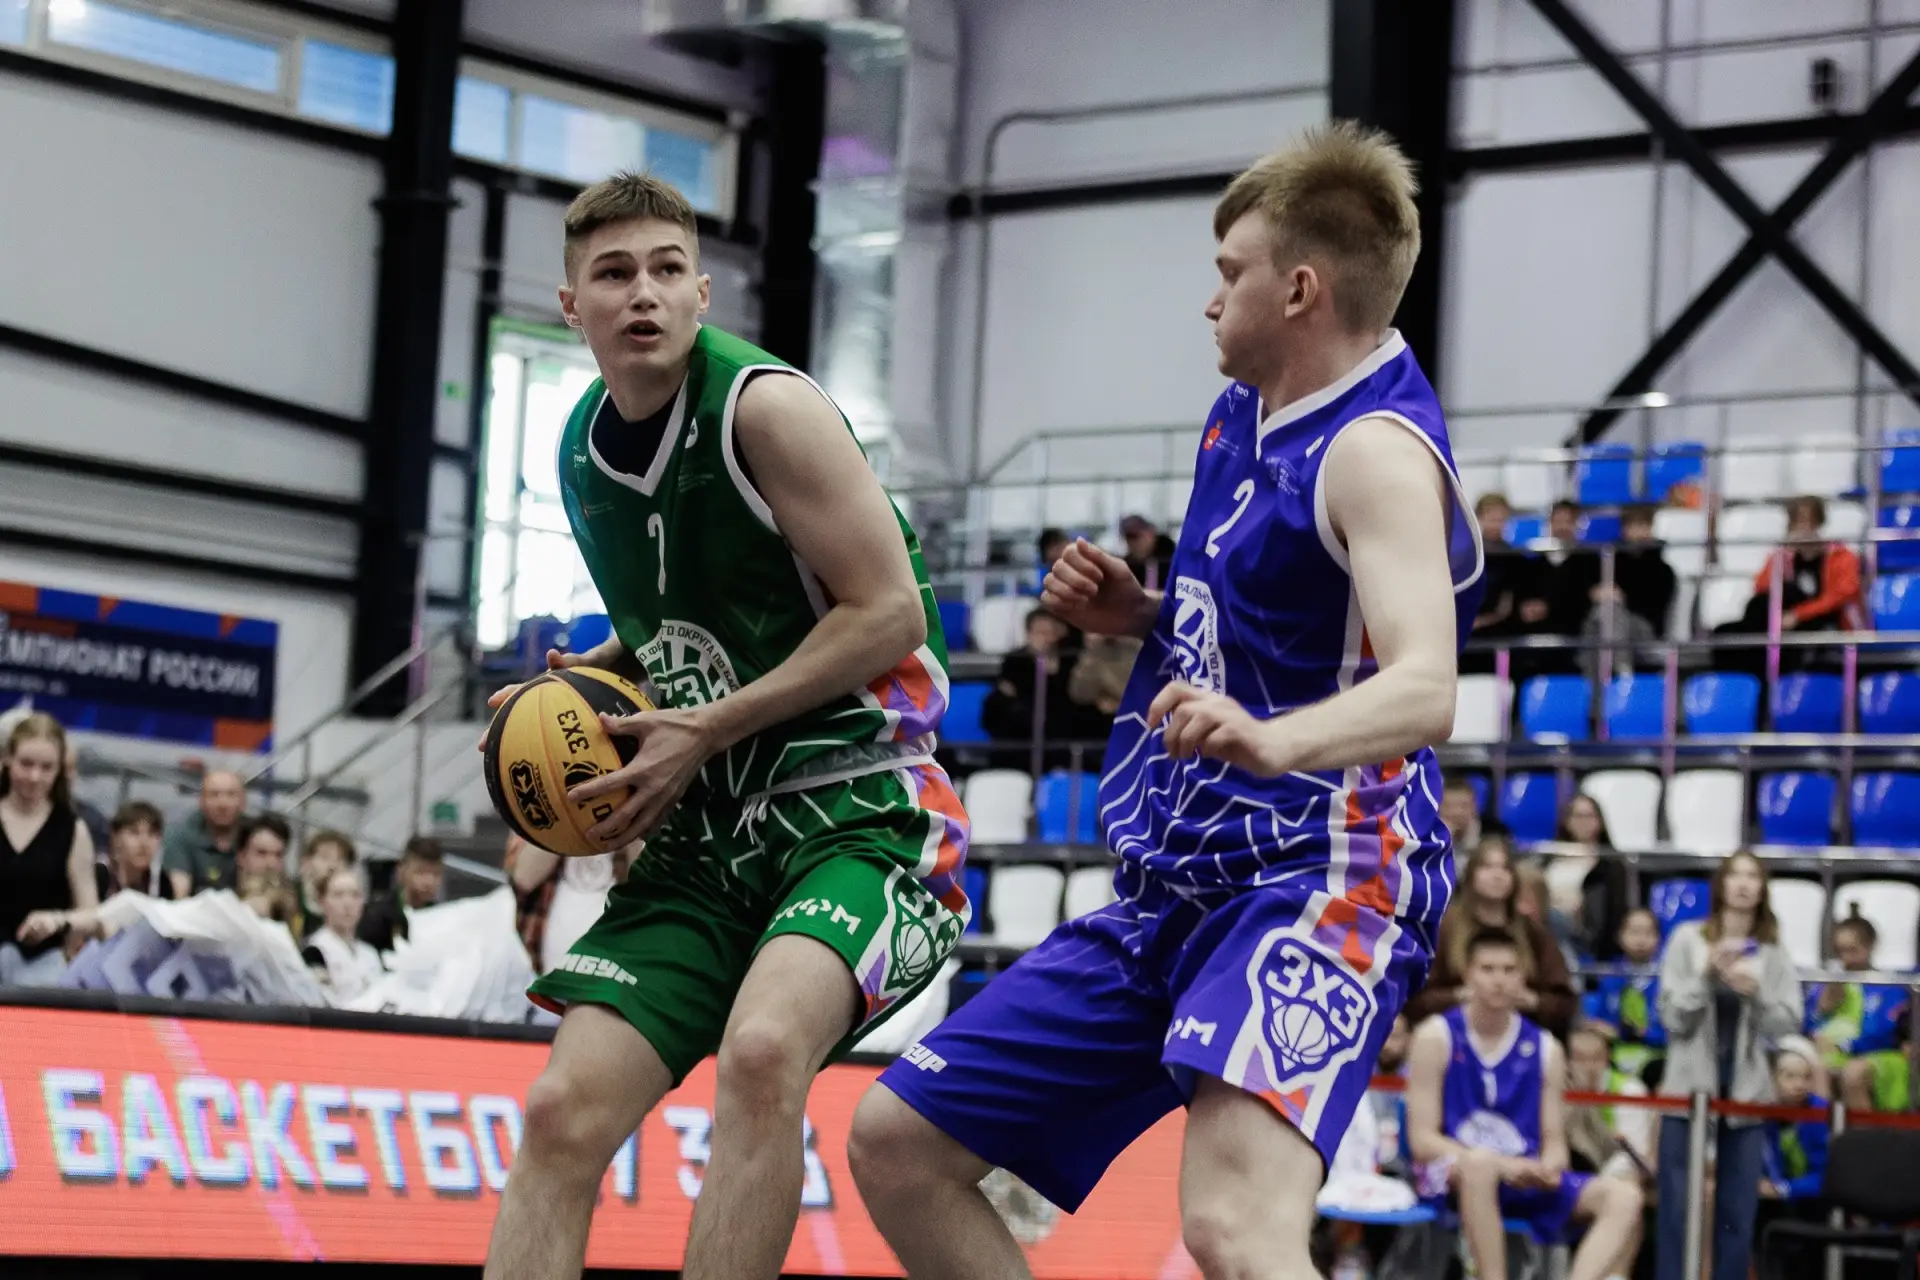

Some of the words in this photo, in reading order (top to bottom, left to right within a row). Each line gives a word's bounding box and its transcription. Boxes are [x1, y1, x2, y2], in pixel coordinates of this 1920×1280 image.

[1205, 478, 1255, 559] 2
[147, 648, 260, 698] РОССИИ
[677, 626, 715, 656] ОКРУГА
[1265, 944, 1368, 1041] 3X3
